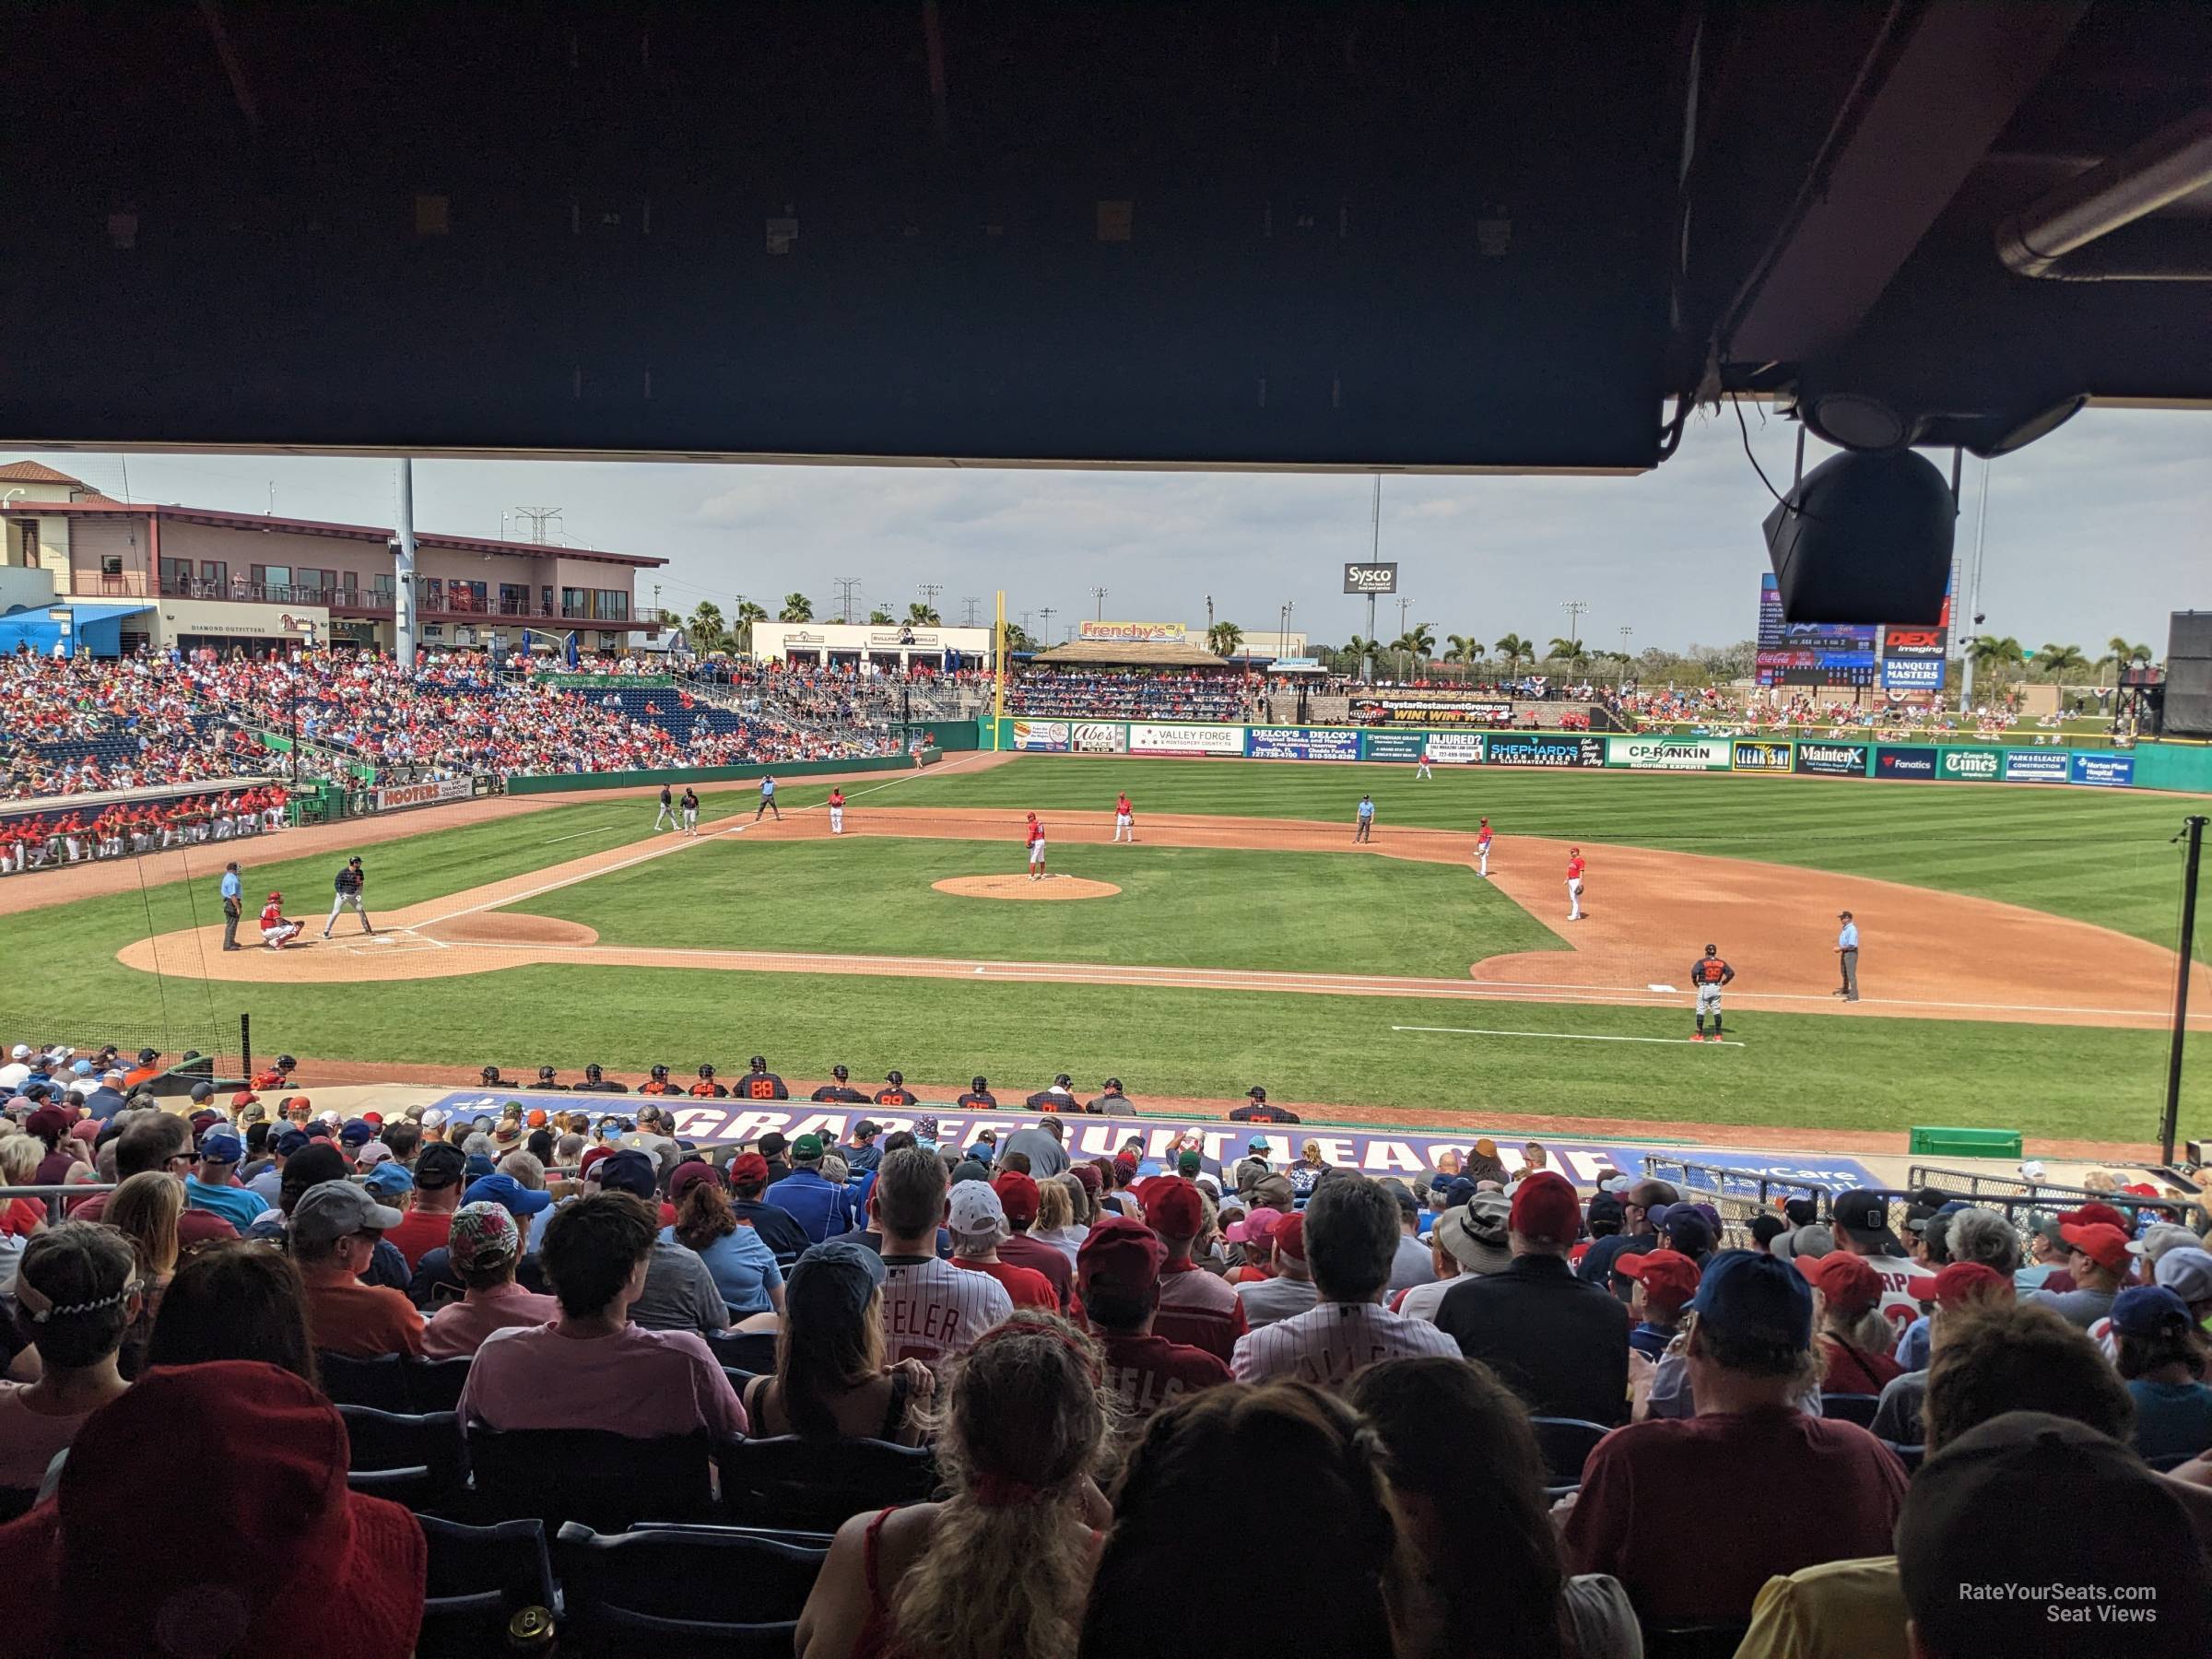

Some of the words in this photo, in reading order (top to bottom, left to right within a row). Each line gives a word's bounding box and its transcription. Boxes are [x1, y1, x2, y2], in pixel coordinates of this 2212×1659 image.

[1349, 566, 1391, 585] Sysco
[1082, 623, 1166, 639] Frenchy's
[1886, 632, 1940, 646] DEX
[1898, 645, 1944, 653] Imaging
[1887, 662, 1939, 670] BANQUET
[1887, 671, 1938, 679] MASTERS
[1382, 701, 1509, 712] BaystarRestaurantGroup.com
[1394, 710, 1427, 720] WIN!
[1429, 711, 1461, 721] WIN!
[1073, 724, 1114, 741] Abe's
[1159, 731, 1197, 739] VALLEY
[1200, 732, 1232, 740] FORGE
[1310, 731, 1357, 739] DELCO'S
[1429, 734, 1482, 745] INJURED?
[1491, 745, 1578, 756] SHEPHARD'S
[1736, 748, 1765, 765] CLEAR
[1771, 748, 1789, 765] SKY
[1799, 746, 1863, 766] MaintenX
[1895, 760, 1931, 769] Fanatics
[1946, 753, 1997, 771] Times
[384, 784, 439, 805] HOOTERS
[751, 1080, 773, 1099] 88
[673, 1108, 1236, 1161] GRAPEFUIT
